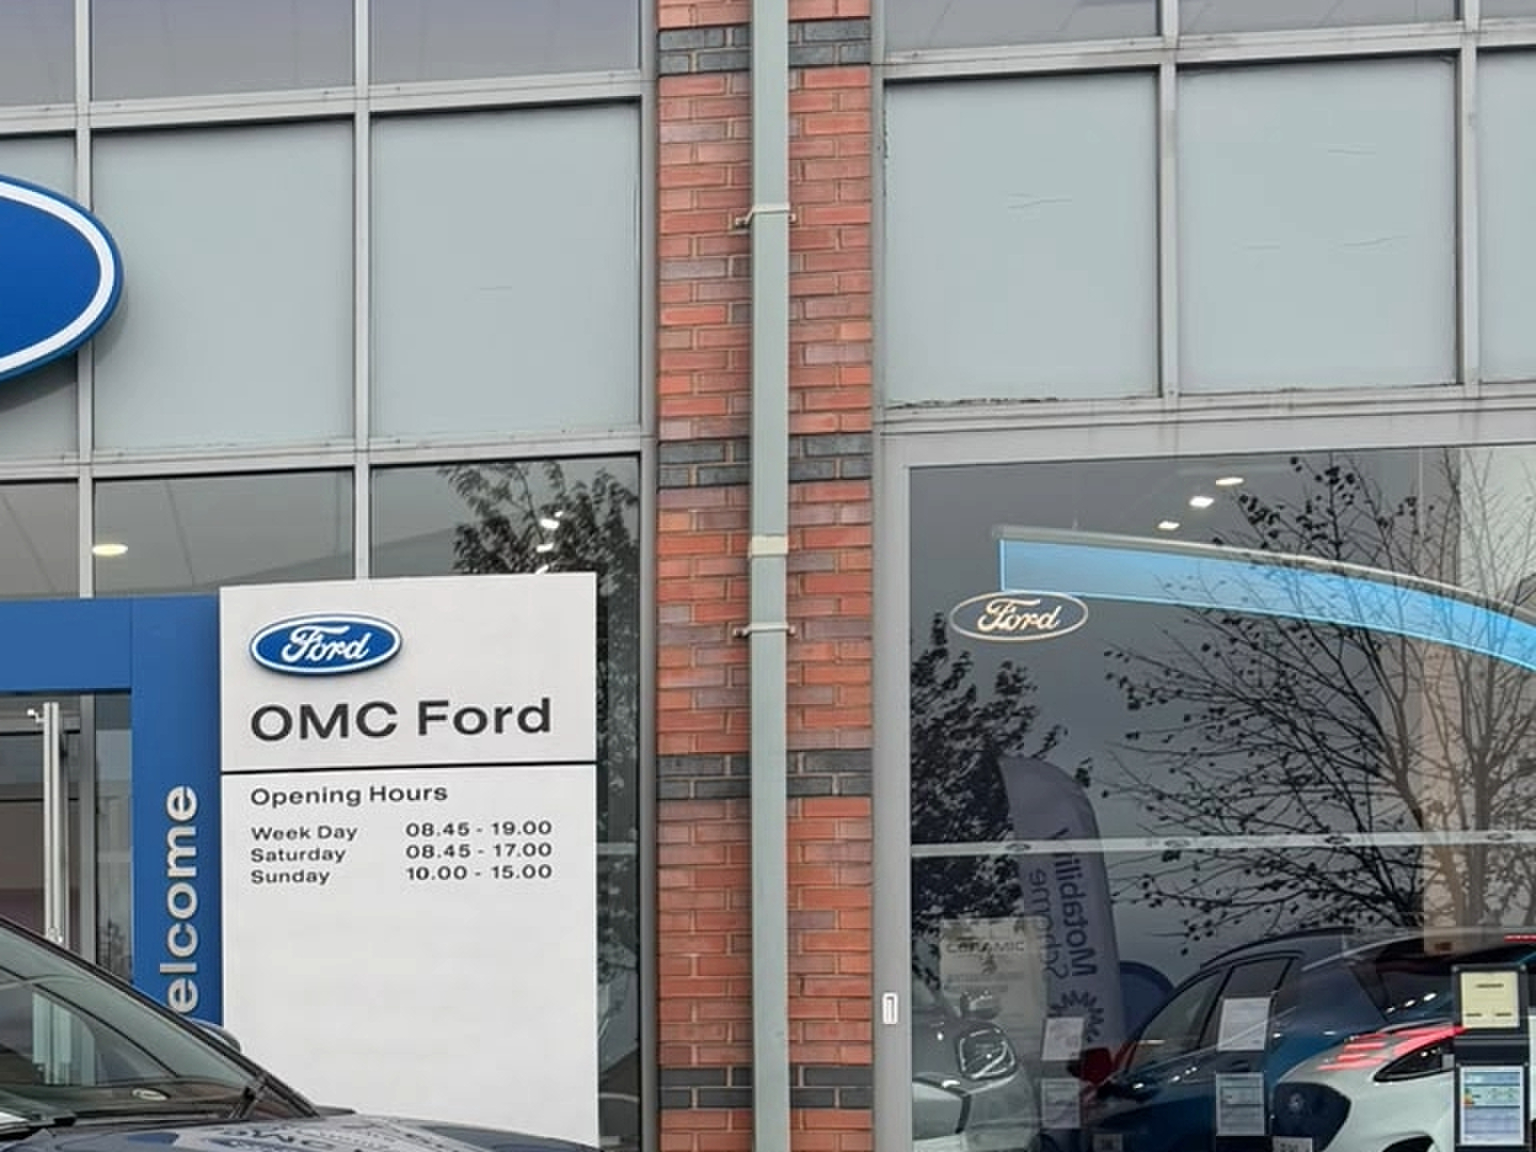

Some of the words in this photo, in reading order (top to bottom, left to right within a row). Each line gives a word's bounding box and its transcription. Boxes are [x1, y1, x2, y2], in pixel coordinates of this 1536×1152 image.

[976, 597, 1063, 632] Ford
[280, 624, 372, 664] Ford
[251, 701, 397, 742] OMC
[418, 697, 551, 736] Ford
[250, 787, 361, 809] Opening
[369, 785, 448, 802] Hours
[251, 826, 311, 841] Week
[317, 825, 358, 842] Day
[405, 822, 470, 838] 08.45
[492, 820, 552, 836] 19.00
[250, 847, 346, 863] Saturday
[405, 843, 471, 859] 08.45
[493, 842, 552, 857] 17.00
[250, 869, 330, 886] Sunday
[407, 865, 468, 881] 10.00
[492, 863, 552, 879] 15.00
[159, 785, 199, 1014] elcome
